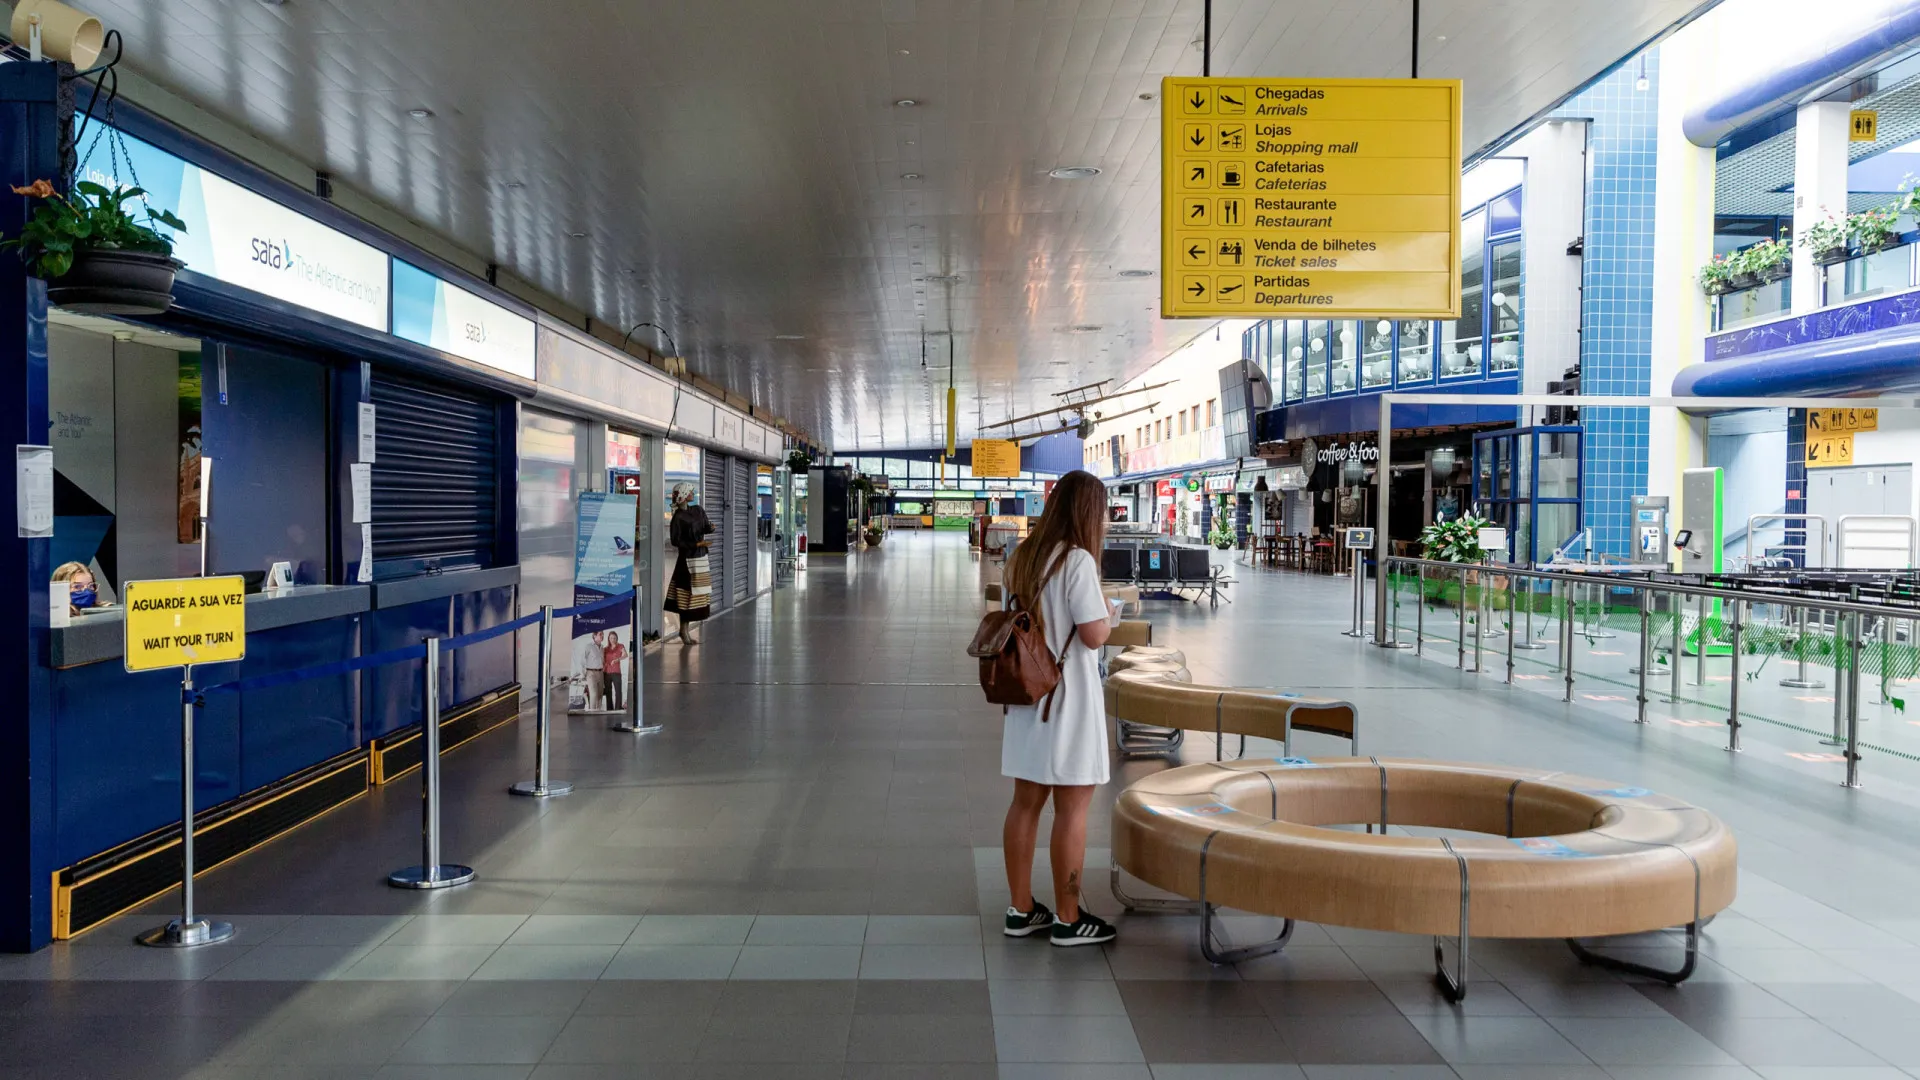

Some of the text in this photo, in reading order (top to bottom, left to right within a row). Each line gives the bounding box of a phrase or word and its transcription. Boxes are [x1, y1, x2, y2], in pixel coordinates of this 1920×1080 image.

[1255, 87, 1325, 101] Chegadas
[1256, 104, 1308, 116] Arrivals
[1255, 124, 1292, 138] Lojas
[1255, 141, 1359, 156] Shopping mall
[1255, 161, 1325, 173] Cafetarias
[1255, 178, 1327, 190] Cafeterias
[1254, 198, 1337, 210] Restaurante
[1255, 215, 1333, 227] Restaurant
[1254, 239, 1377, 251] Venda de bilhetes
[251, 237, 281, 269] sata
[296, 253, 313, 282] The
[315, 262, 347, 295] Atlantic
[1254, 256, 1338, 268] Ticket sales
[1254, 275, 1310, 287] Partidas
[1255, 292, 1333, 306] Departures
[465, 322, 480, 343] sata
[1317, 442, 1348, 466] coffee
[1348, 442, 1358, 459] &
[132, 593, 243, 611] AGUARDE A SUA VEZ
[143, 631, 234, 650] WAIT YOUR TURN
